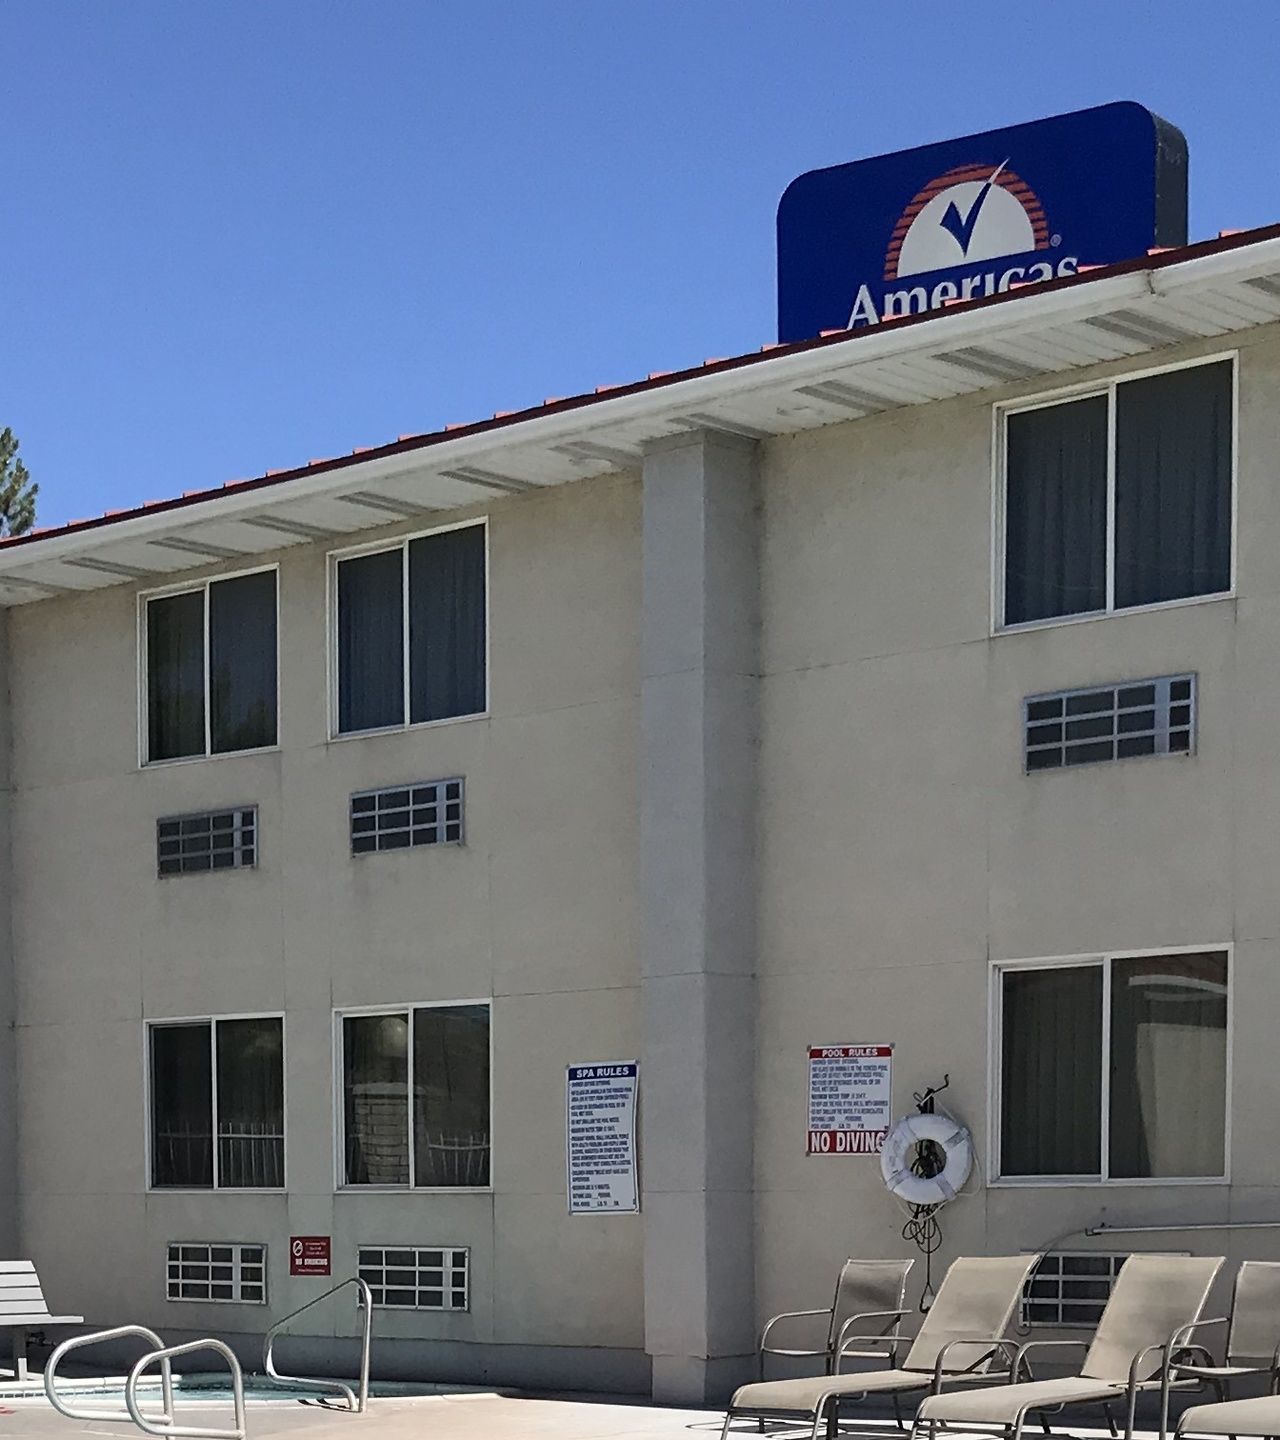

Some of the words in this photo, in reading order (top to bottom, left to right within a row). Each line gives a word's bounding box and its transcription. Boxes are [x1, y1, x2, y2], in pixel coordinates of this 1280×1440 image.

[822, 1049, 846, 1058] POOL
[848, 1048, 878, 1057] RULES
[576, 1068, 595, 1078] SPA
[596, 1066, 629, 1077] RULES
[811, 1132, 830, 1152] NO
[836, 1131, 886, 1152] DIVING
